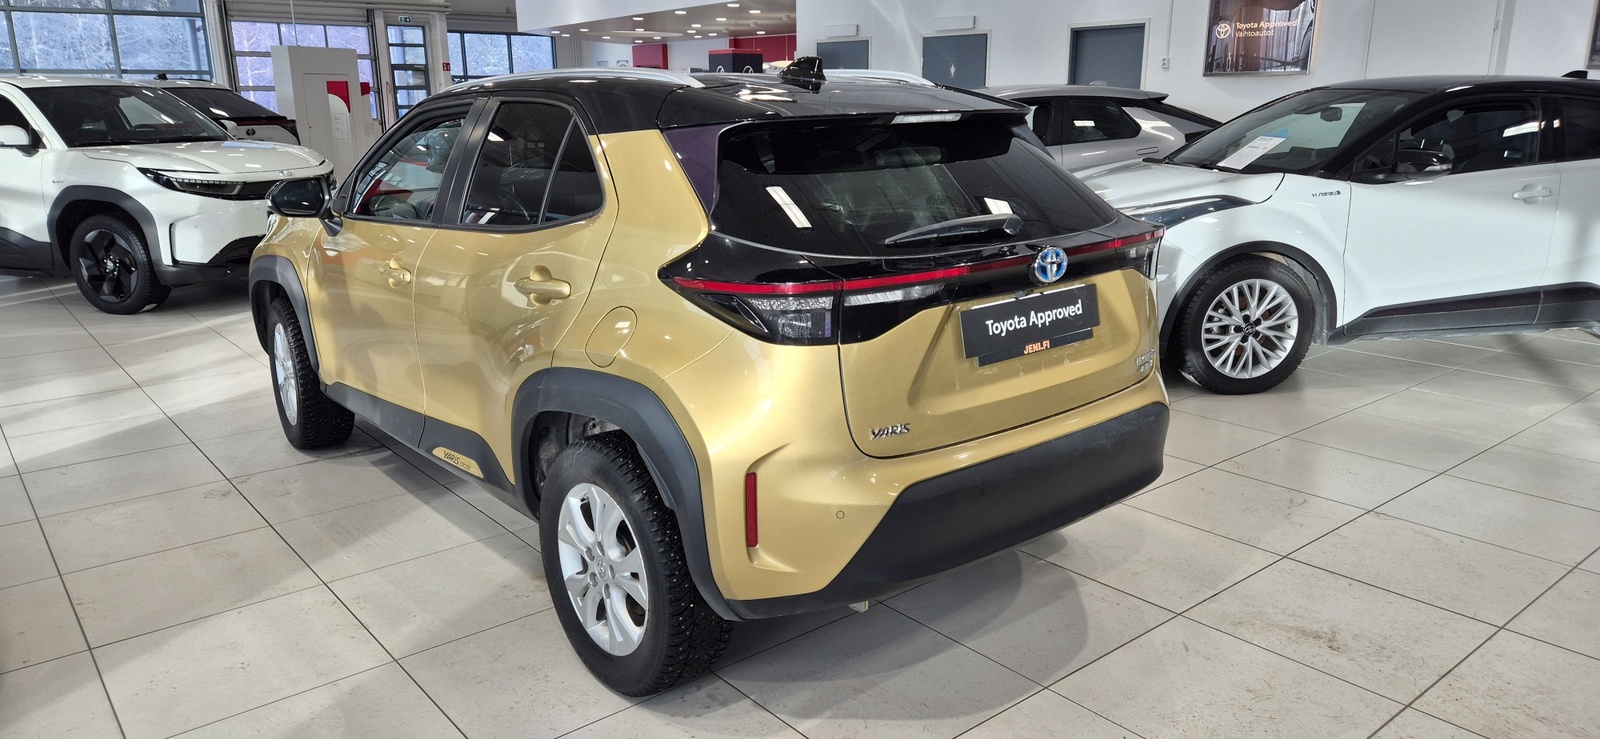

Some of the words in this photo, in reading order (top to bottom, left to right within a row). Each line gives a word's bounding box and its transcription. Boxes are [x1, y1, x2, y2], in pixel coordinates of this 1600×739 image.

[1236, 22, 1258, 31] Toyota
[1259, 20, 1297, 29] Approved
[1235, 29, 1274, 38] Vaihtoautot
[985, 315, 1027, 337] Toyota
[1029, 299, 1082, 328] Approved
[1023, 339, 1050, 355] JENI.FI
[869, 422, 911, 440] YARIS
[443, 450, 460, 465] YARIS
